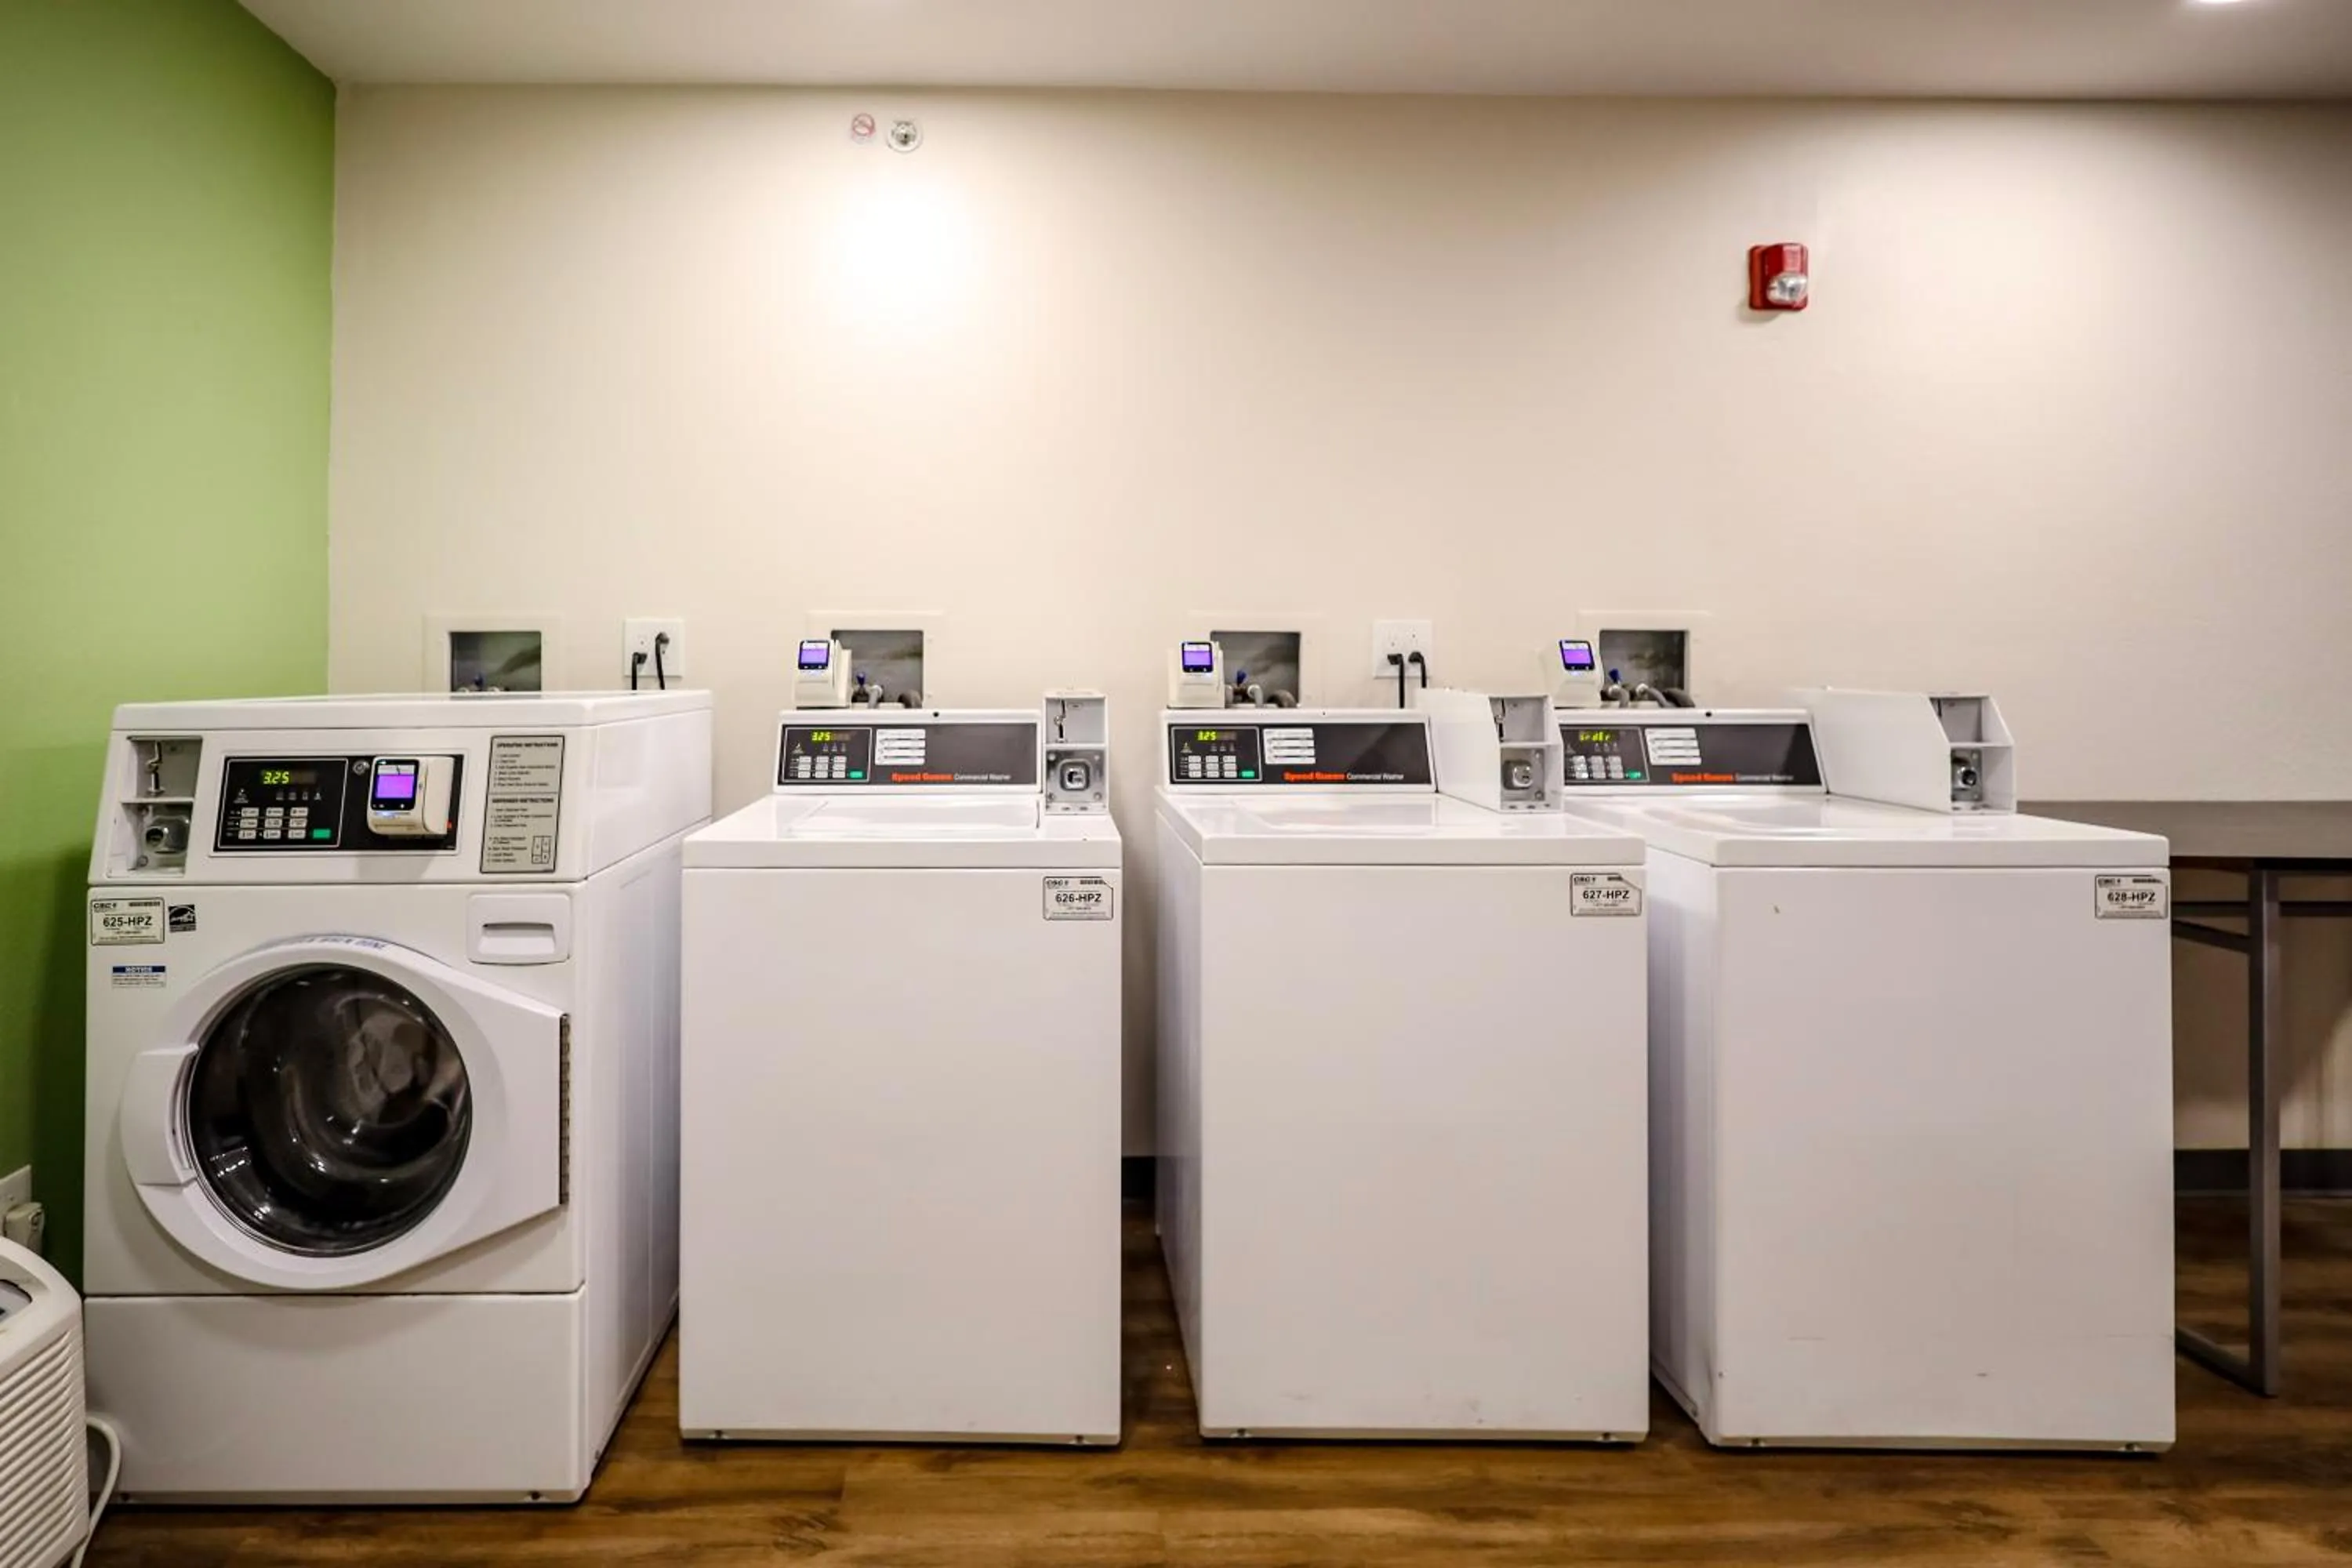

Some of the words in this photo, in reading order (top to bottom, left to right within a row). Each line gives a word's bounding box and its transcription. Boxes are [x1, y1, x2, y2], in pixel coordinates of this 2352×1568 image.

[1055, 893, 1102, 903] 626-HPZ
[1582, 890, 1630, 899] 627-HPZ
[103, 916, 153, 927] 625-HPZ
